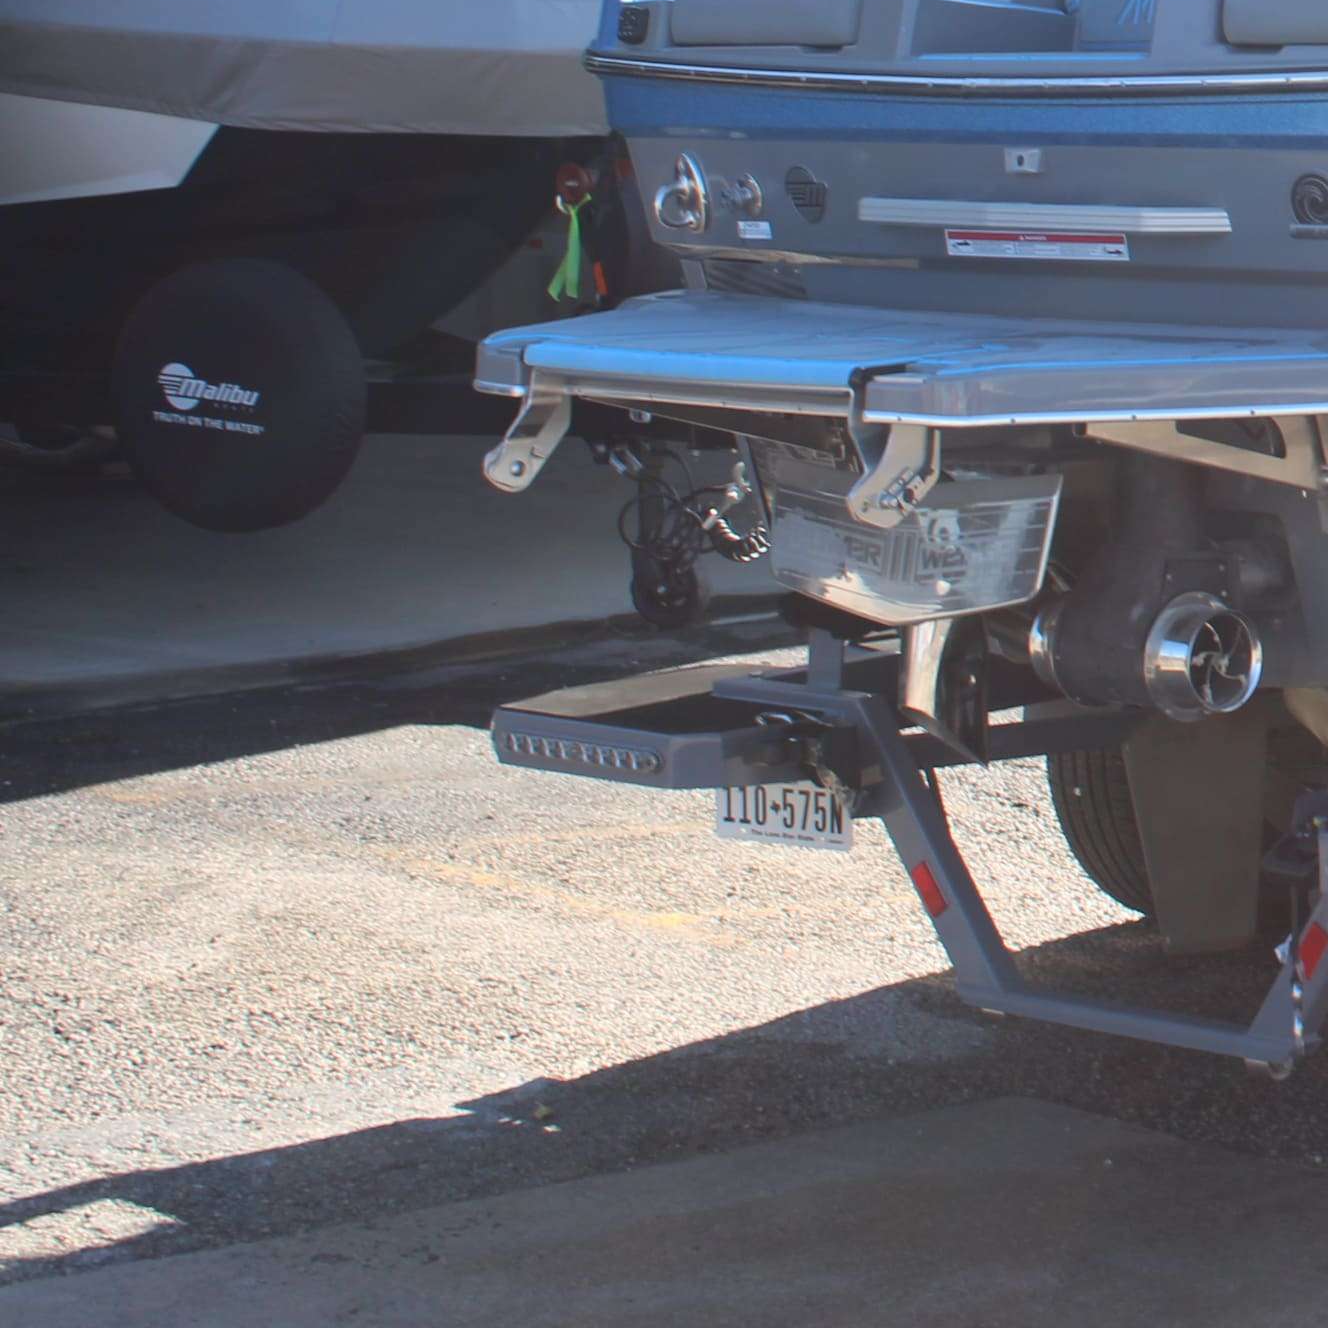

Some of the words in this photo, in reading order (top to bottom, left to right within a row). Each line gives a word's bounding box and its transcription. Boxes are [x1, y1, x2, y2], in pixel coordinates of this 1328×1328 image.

[178, 377, 260, 407] Malibu
[151, 410, 187, 424] TRUTH
[203, 416, 225, 430] THE
